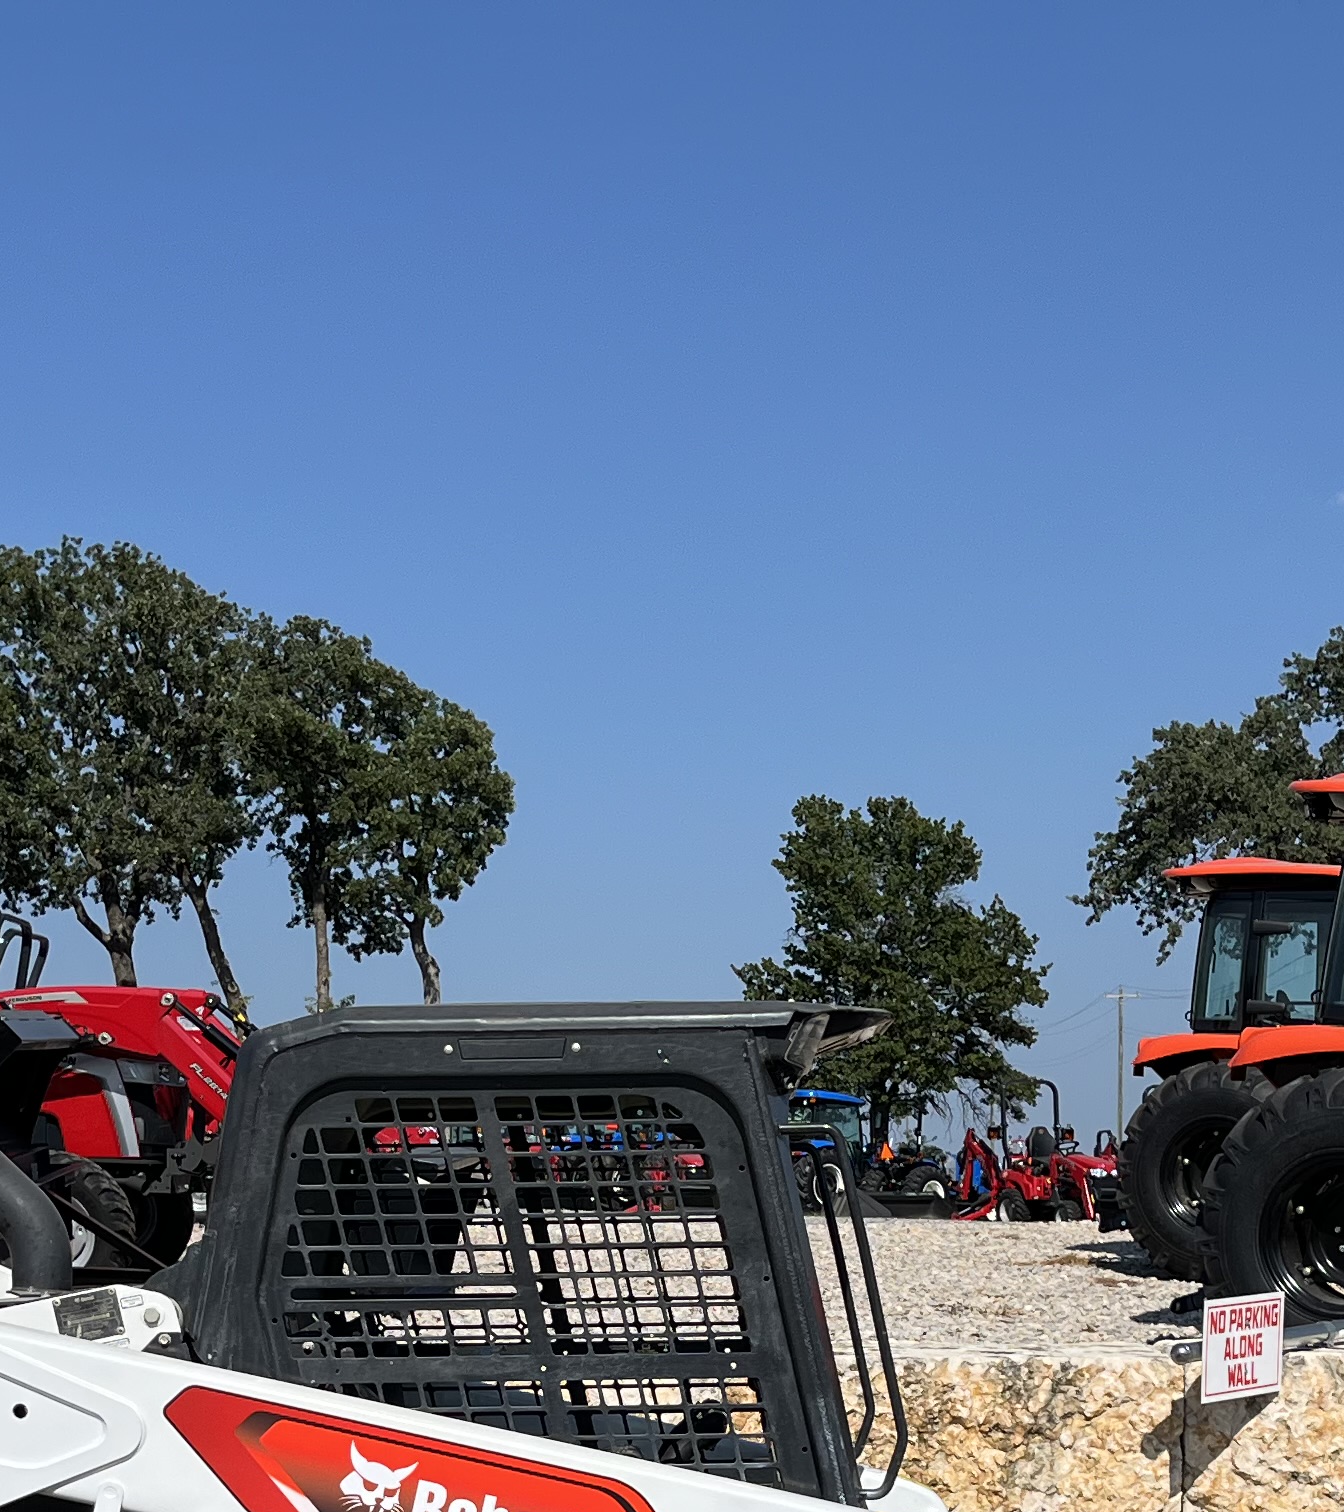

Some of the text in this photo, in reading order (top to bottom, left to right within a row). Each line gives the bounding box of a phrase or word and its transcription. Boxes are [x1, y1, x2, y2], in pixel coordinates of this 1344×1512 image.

[1209, 1303, 1279, 1336] NO PARKING
[1223, 1332, 1263, 1361] ALONG
[1227, 1361, 1258, 1388] WALL
